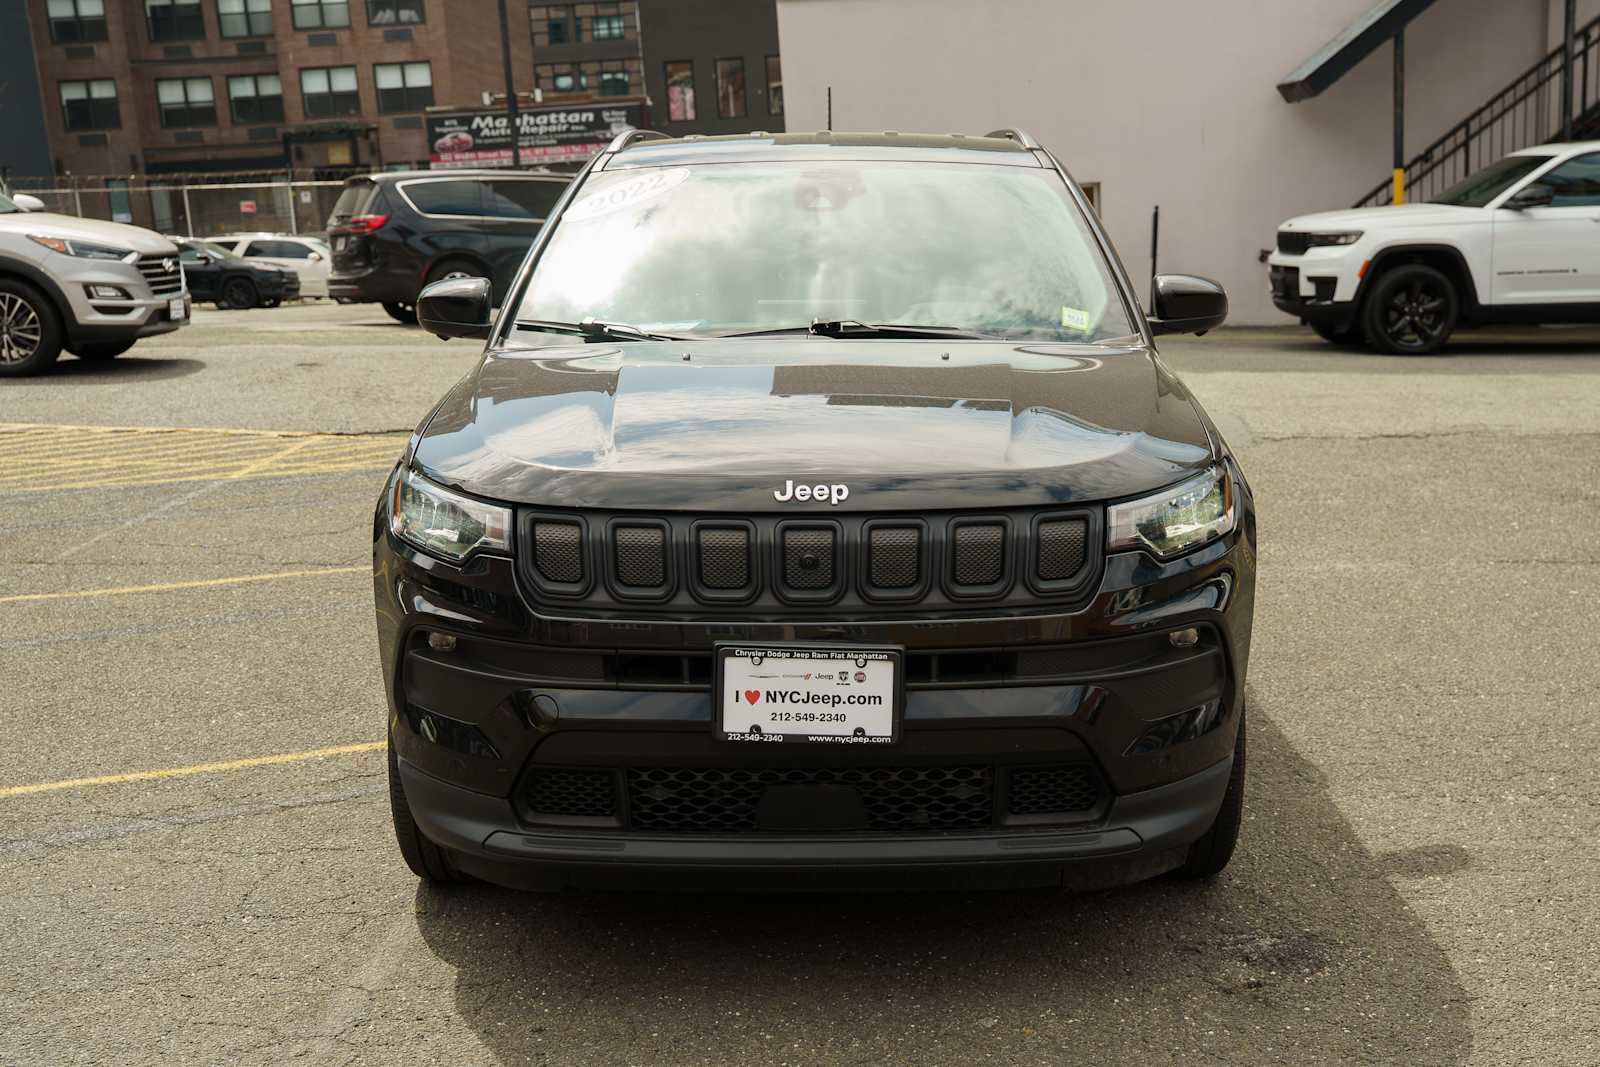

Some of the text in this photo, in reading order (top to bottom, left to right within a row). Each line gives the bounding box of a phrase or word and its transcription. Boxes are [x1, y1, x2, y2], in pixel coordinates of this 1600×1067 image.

[520, 123, 569, 136] Repair
[774, 480, 849, 505] Jeep
[735, 649, 765, 658] Chrysler
[767, 650, 790, 658] Dodge
[792, 651, 810, 659] Jeep
[830, 652, 845, 660] Fiat
[847, 653, 888, 661] Manhattan
[815, 673, 834, 681] Jeep
[735, 690, 882, 708] I NYCJeep.com
[770, 712, 847, 722] 212-549-2340
[727, 732, 783, 742] 212-549-2340
[808, 735, 891, 744] www.nycjeep.com
